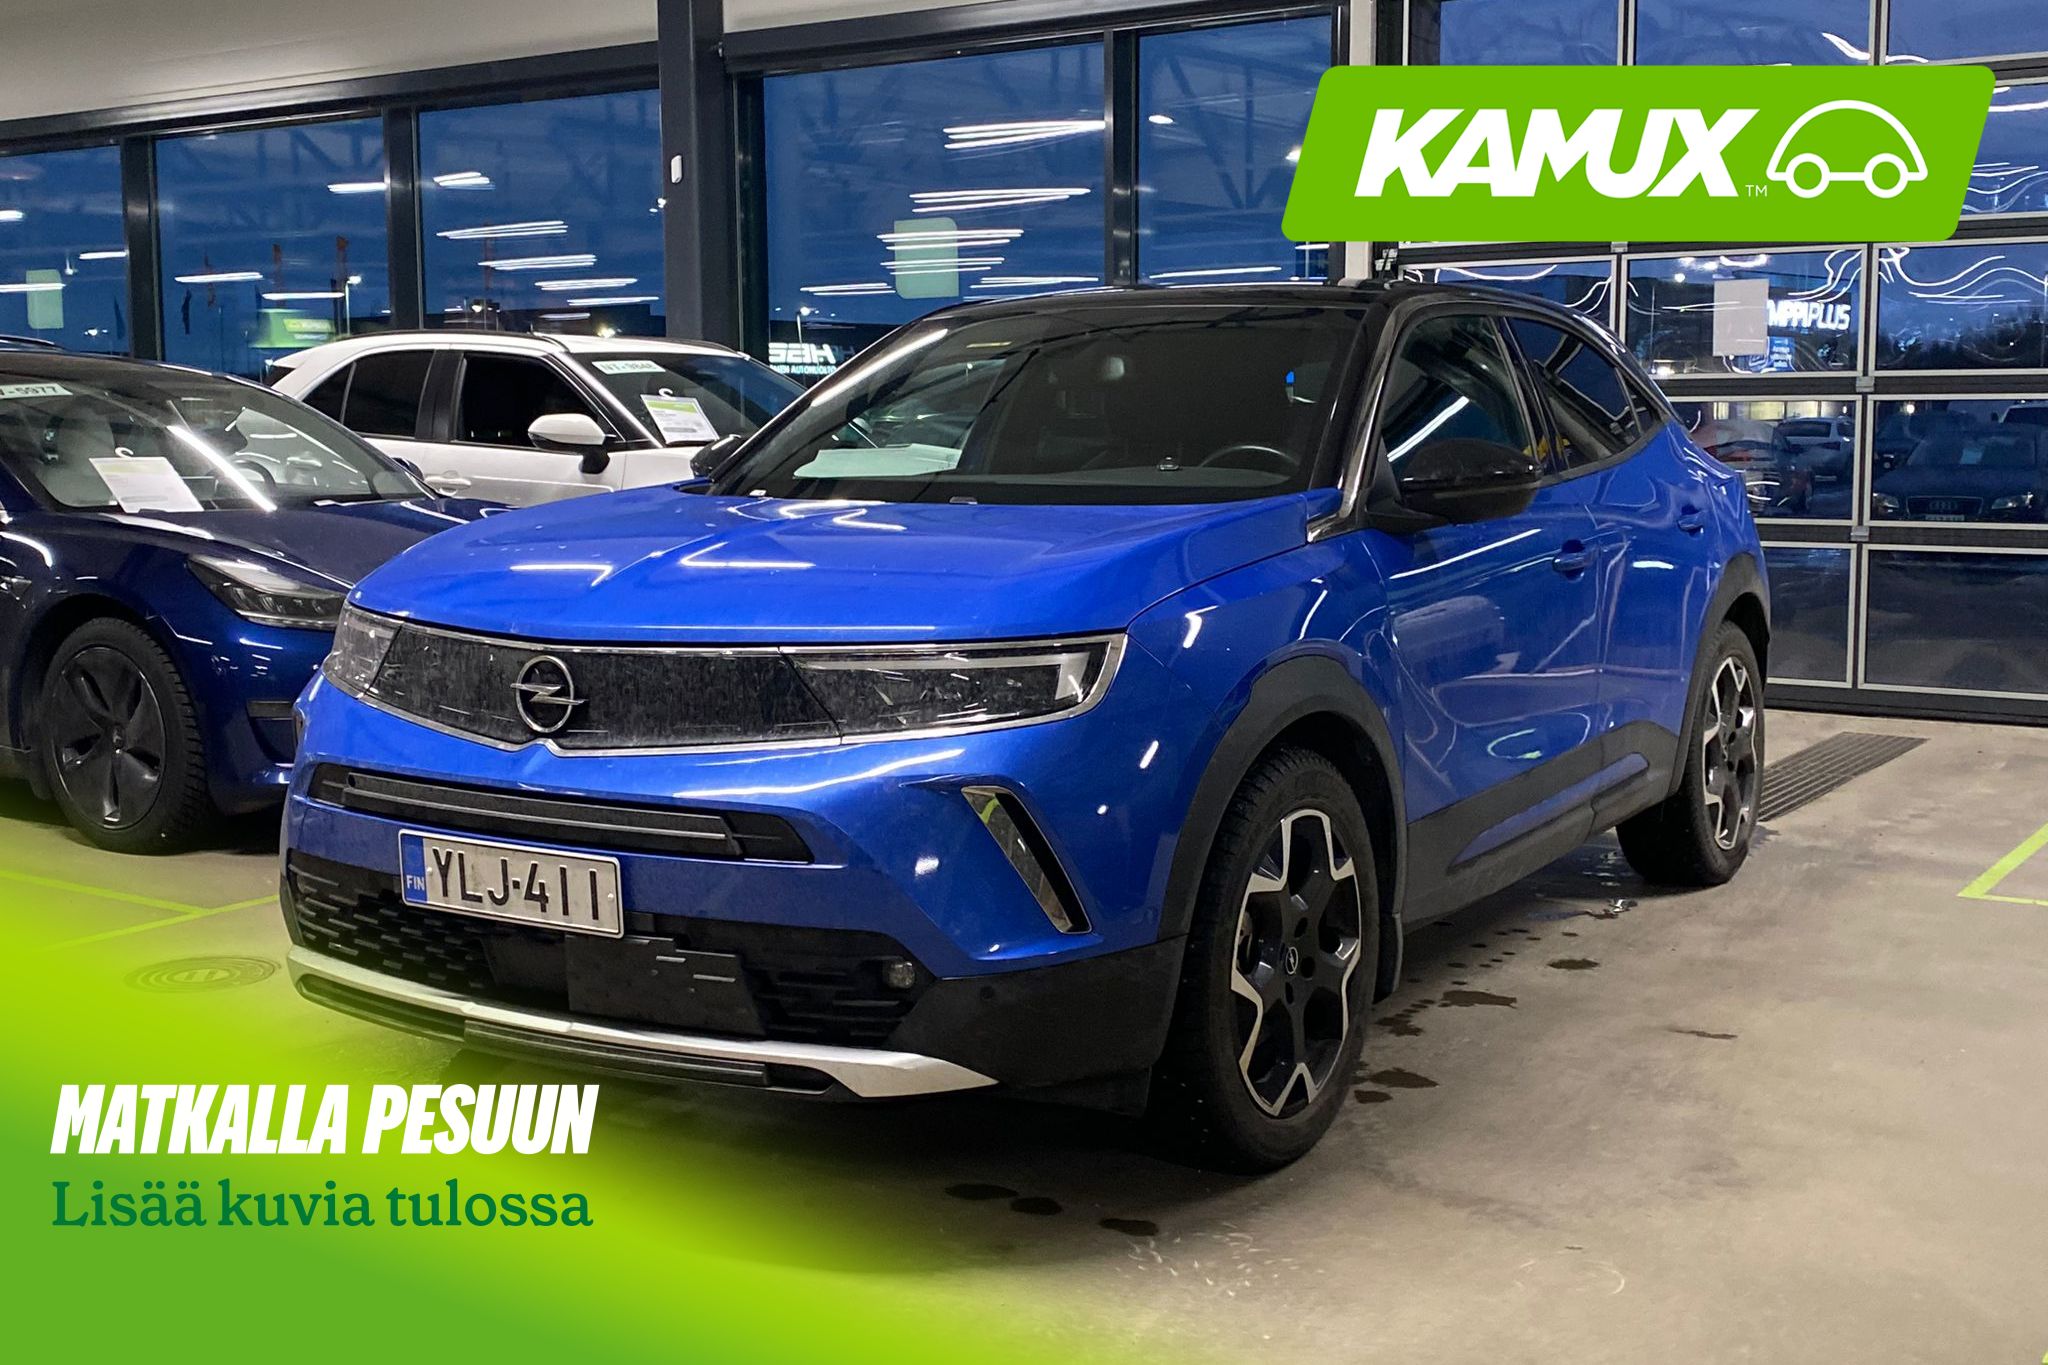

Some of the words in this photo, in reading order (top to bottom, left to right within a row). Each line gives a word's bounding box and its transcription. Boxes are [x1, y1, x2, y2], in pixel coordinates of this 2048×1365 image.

[1767, 300, 1851, 331] MPPIPLUS
[406, 874, 426, 892] FIN
[431, 847, 599, 921] YLJ-411
